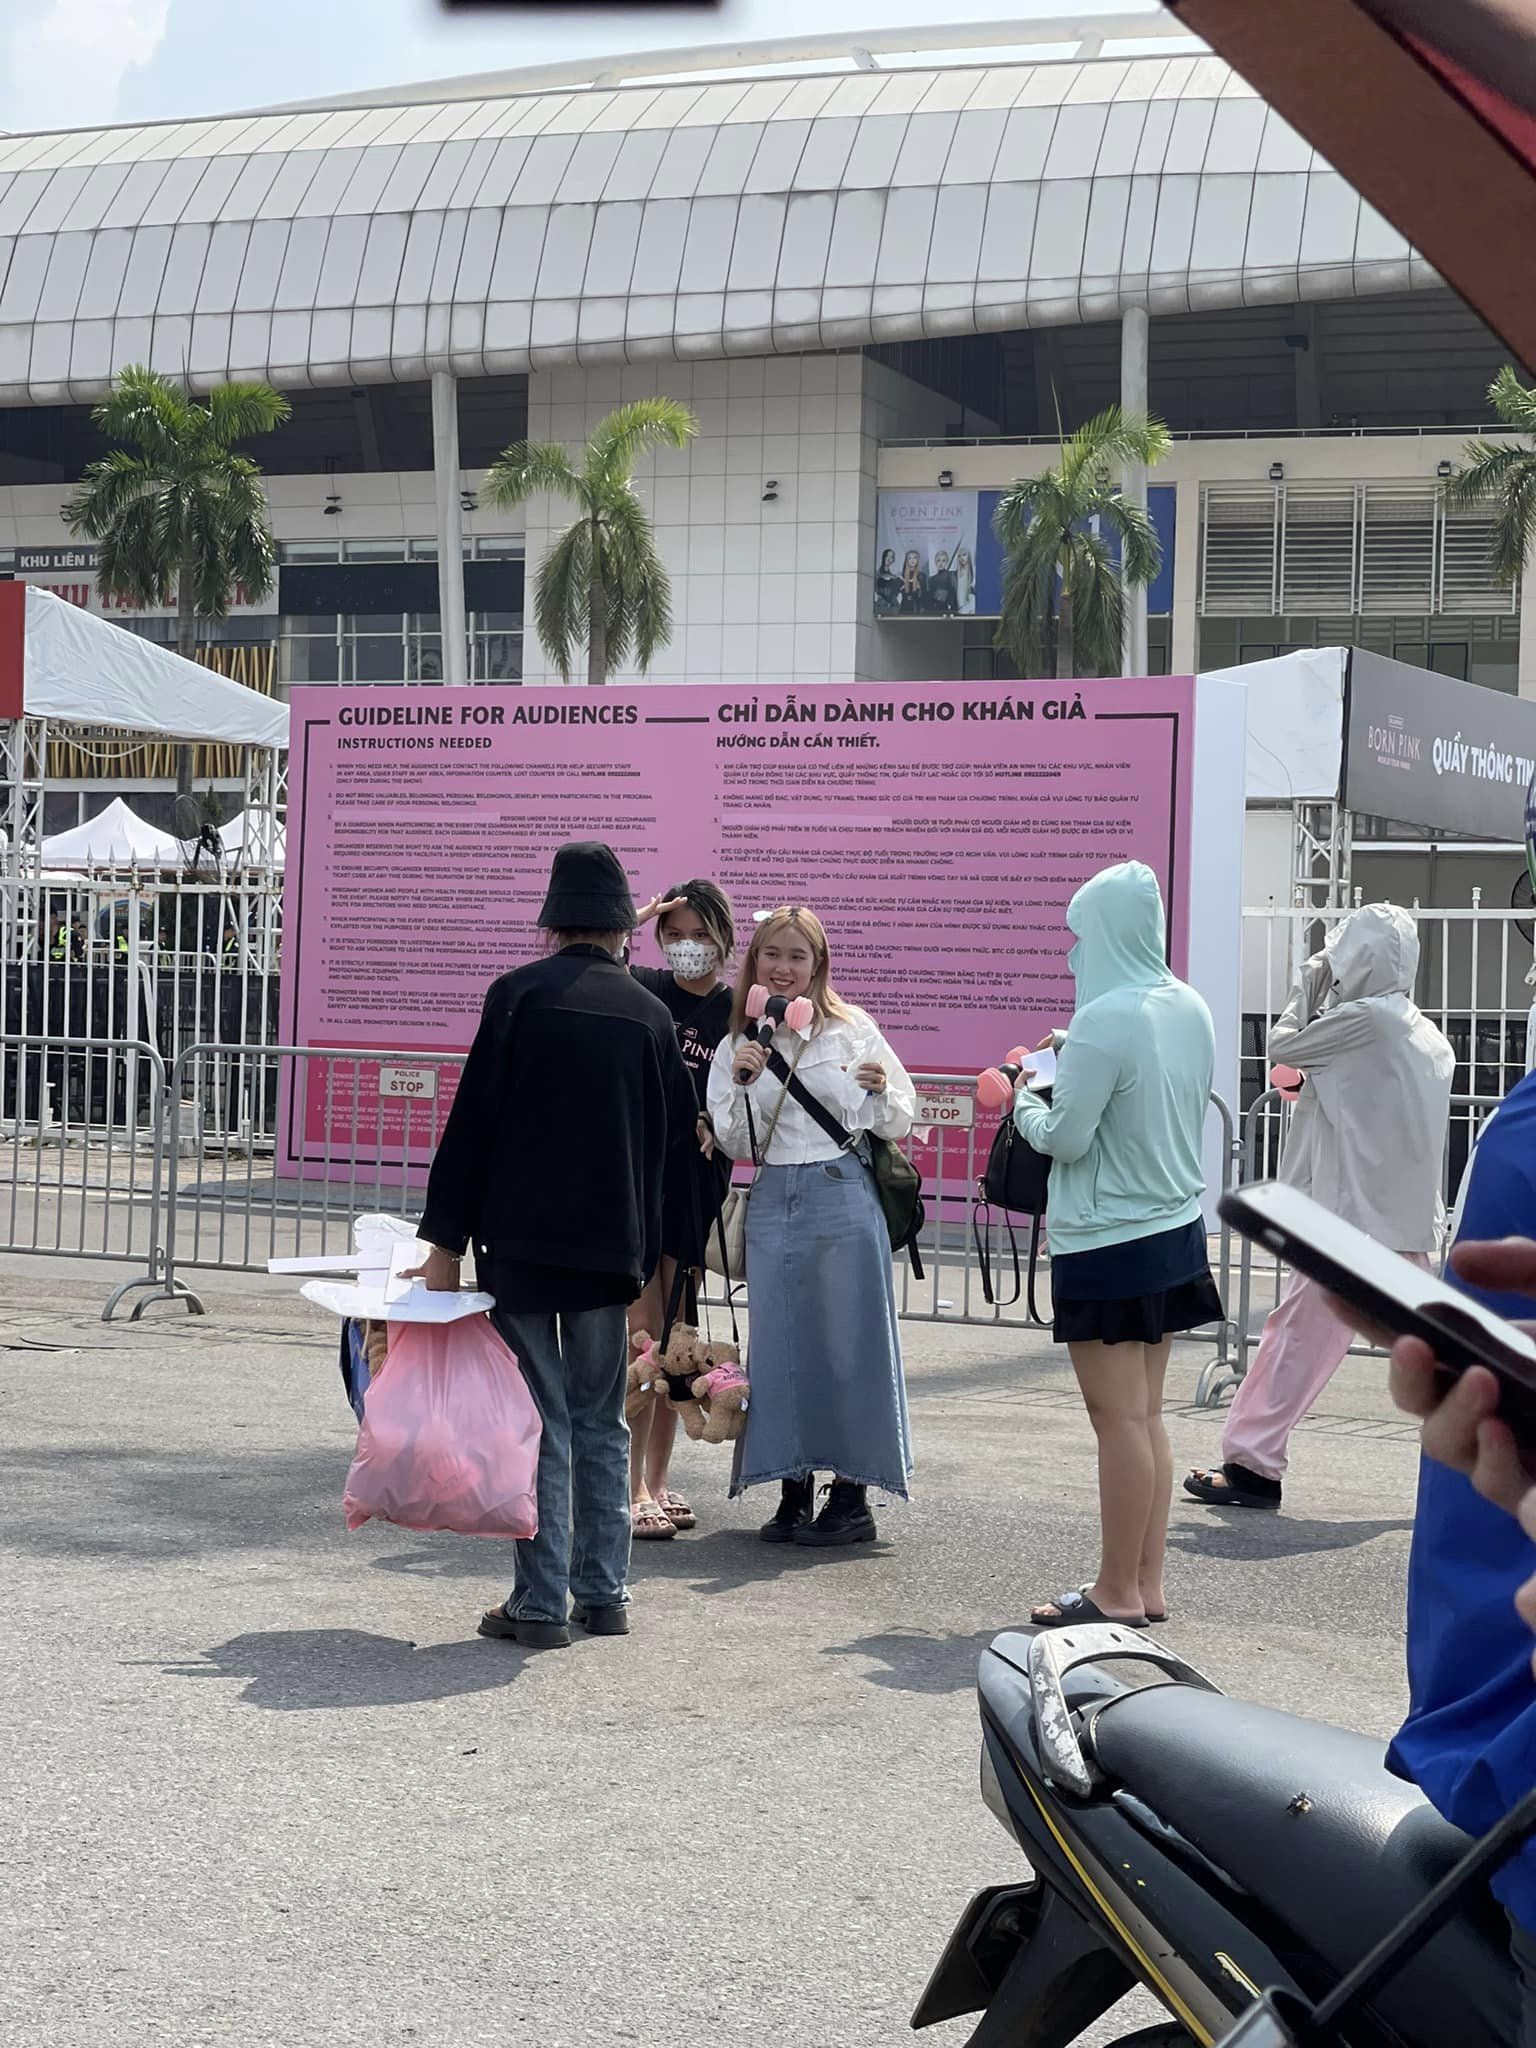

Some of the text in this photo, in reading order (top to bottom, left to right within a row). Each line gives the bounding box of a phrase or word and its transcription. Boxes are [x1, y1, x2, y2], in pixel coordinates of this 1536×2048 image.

[890, 505, 964, 518] BORN PINK
[20, 553, 49, 569] KHU
[53, 551, 85, 568] LIÊN
[717, 693, 1087, 723] CHỈ DẪN DÀNH CHO KHÁN GIẢ
[338, 705, 638, 726] GUIDELINE FOR AUDIENCES
[337, 737, 492, 750] INSTRUCTIONS NEEDED
[1368, 726, 1421, 761] BORN PINK
[1471, 742, 1513, 784] THÔNG
[1515, 756, 1535, 787] TIN
[394, 1070, 420, 1078] POLICE
[390, 1080, 424, 1093] STOP
[926, 1096, 955, 1104] POLICE
[921, 1107, 960, 1120] STOP
